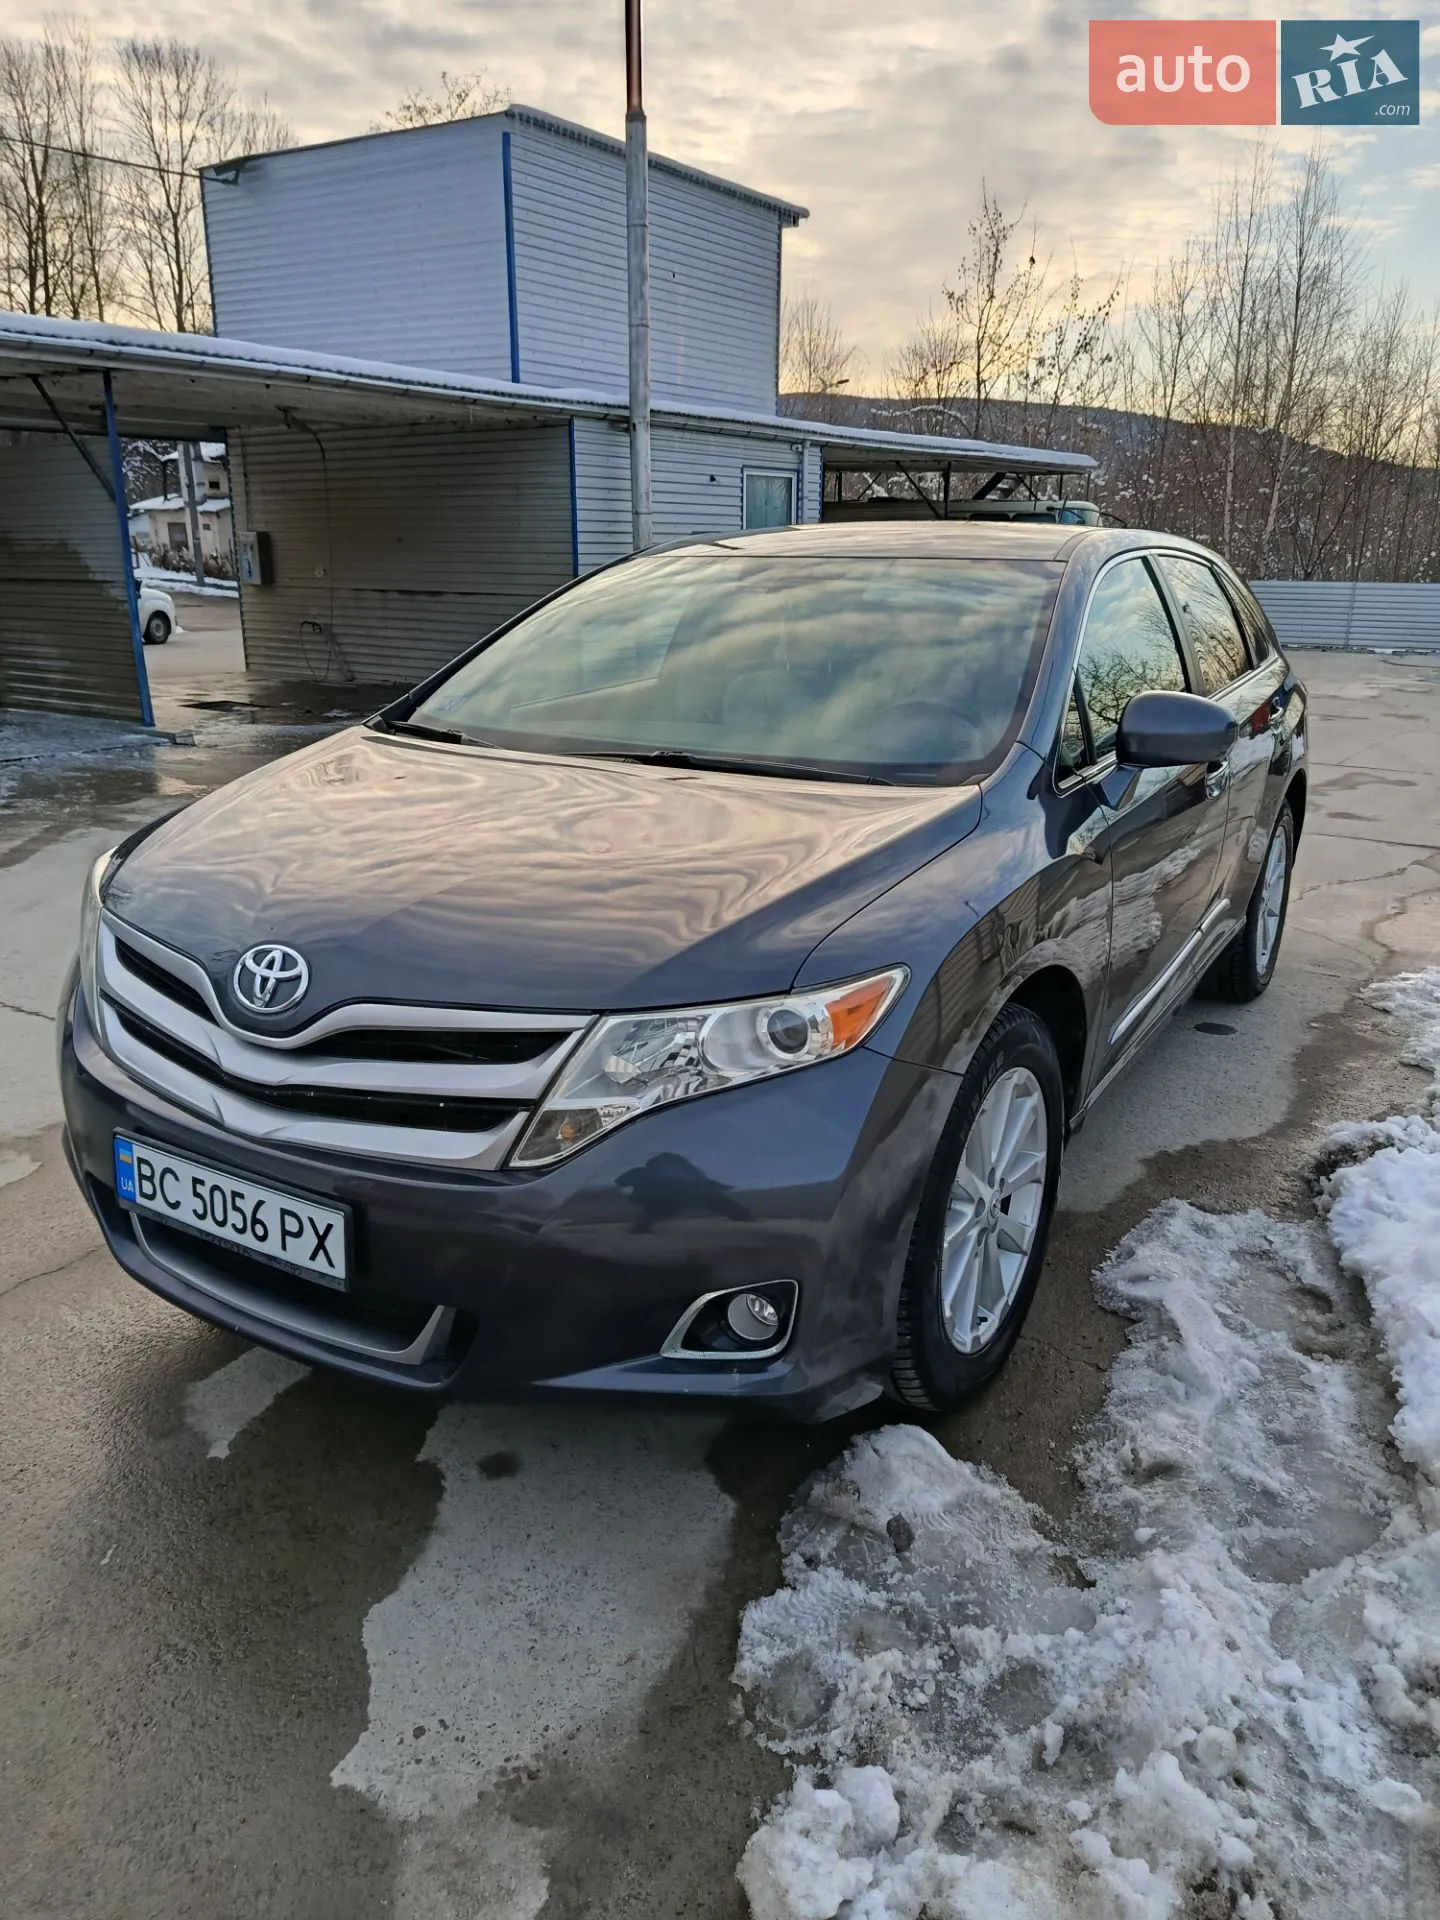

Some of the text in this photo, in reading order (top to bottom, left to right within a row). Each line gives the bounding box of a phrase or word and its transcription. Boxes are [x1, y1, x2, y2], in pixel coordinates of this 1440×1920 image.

[121, 1176, 134, 1193] UA
[136, 1156, 181, 1210] BC
[192, 1175, 269, 1242] 5056
[280, 1207, 336, 1269] PX
